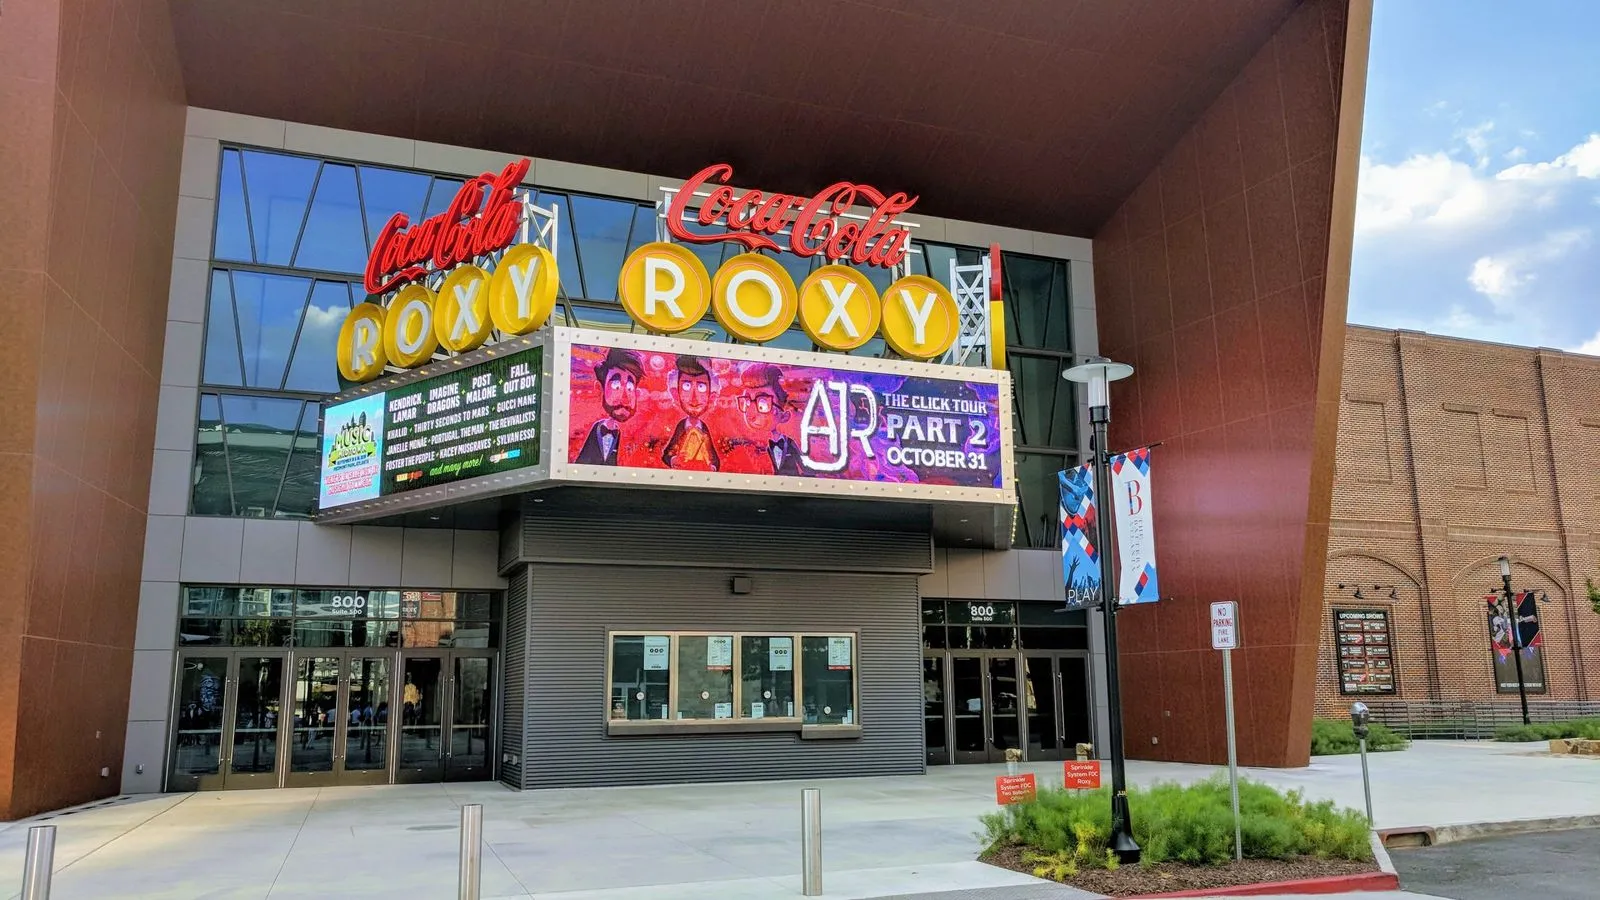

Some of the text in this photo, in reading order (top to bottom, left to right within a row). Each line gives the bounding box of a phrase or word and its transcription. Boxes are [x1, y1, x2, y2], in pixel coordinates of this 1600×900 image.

[667, 163, 920, 269] Coca-Cola
[364, 158, 531, 294] Coca-Cola
[643, 257, 938, 345] ROXY
[351, 256, 541, 372] ROXY
[510, 363, 530, 378] FALL
[472, 373, 492, 388] POST
[503, 374, 537, 394] OUT BOY
[429, 382, 459, 400] IMAGINE
[466, 385, 497, 404] MALONE
[389, 392, 422, 413] KENDRICK
[426, 397, 460, 415] DRAGONS
[496, 394, 537, 413] GUCCI MANE
[882, 393, 987, 415] THE CLICK TOUR
[392, 406, 417, 424] LAMAR
[414, 406, 490, 434] THIRTY SECONDS TO MARS
[489, 411, 536, 431] THE REVIVALISTS
[387, 426, 408, 440] KHALID
[460, 425, 472, 437] THE
[471, 423, 484, 435] MAN
[800, 378, 877, 472] AJR
[886, 414, 987, 446] PART 2
[496, 427, 536, 446] SYLVAN ESSO
[386, 442, 409, 456] JANELLE
[439, 437, 492, 459] KACEY MUSGRAVES
[385, 457, 405, 471] FOSTER
[404, 455, 415, 467] THE
[415, 450, 435, 465] PEOPLE
[429, 462, 443, 476] and
[462, 454, 484, 468] more!
[887, 446, 987, 470] OCTOBER 31
[1124, 479, 1143, 517] B
[332, 595, 366, 608] 800
[1067, 586, 1098, 604] PLAY
[970, 605, 994, 616] 800
[1217, 607, 1227, 616] NO
[1213, 619, 1233, 627] PARKING
[1218, 628, 1229, 636] FIRE
[1067, 771, 1087, 779] System
